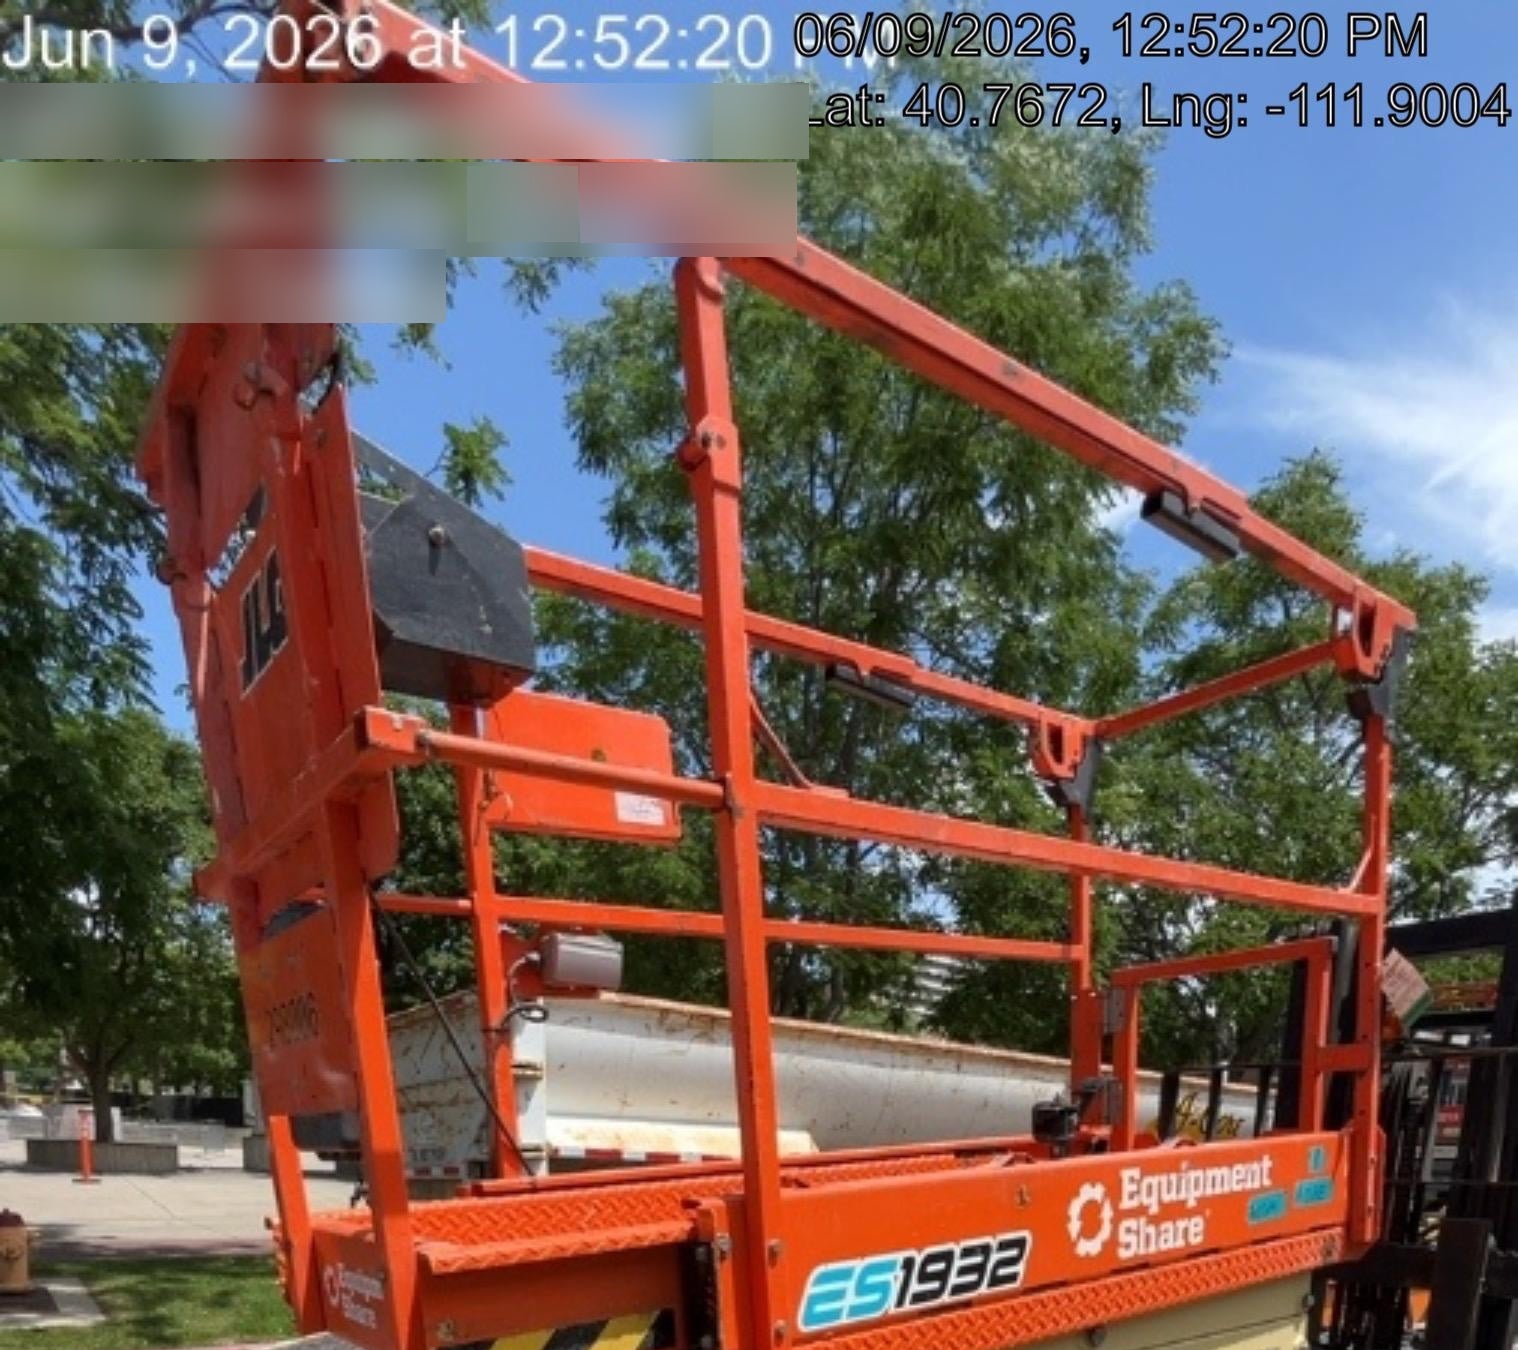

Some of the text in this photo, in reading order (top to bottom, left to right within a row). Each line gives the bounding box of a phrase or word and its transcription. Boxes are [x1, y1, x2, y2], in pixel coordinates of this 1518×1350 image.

[1119, 1154, 1272, 1216] Equipment
[1118, 1213, 1205, 1260] Share
[801, 1232, 1030, 1330] ES1932
